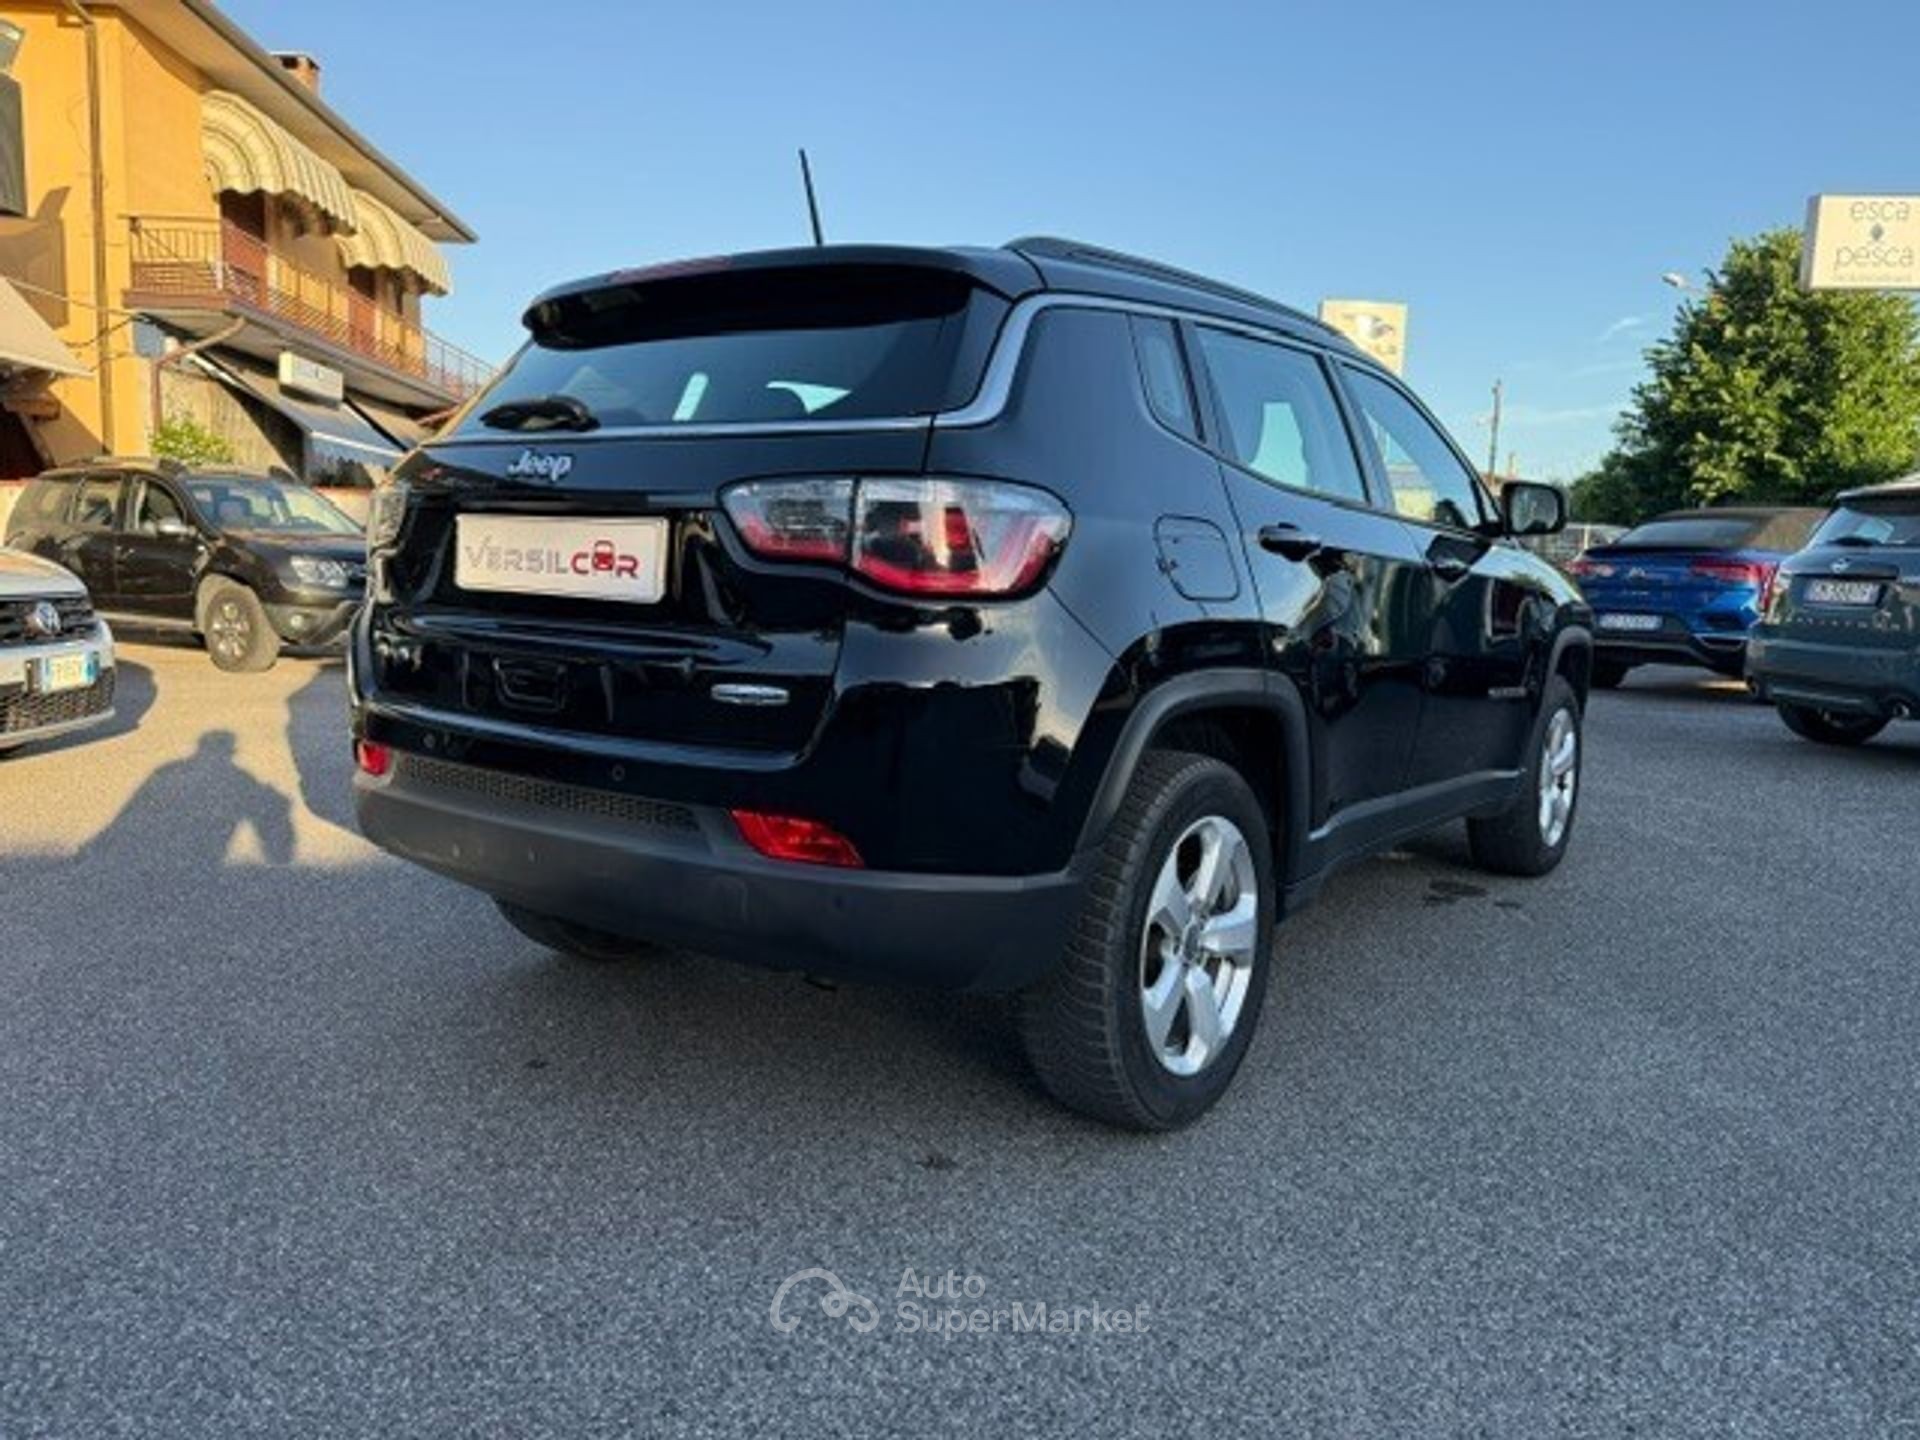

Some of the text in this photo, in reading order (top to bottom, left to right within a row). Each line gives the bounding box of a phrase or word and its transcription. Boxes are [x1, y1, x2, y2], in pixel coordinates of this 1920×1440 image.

[1850, 201, 1911, 221] esca
[1834, 246, 1914, 271] pesca
[507, 451, 572, 481] Jeep
